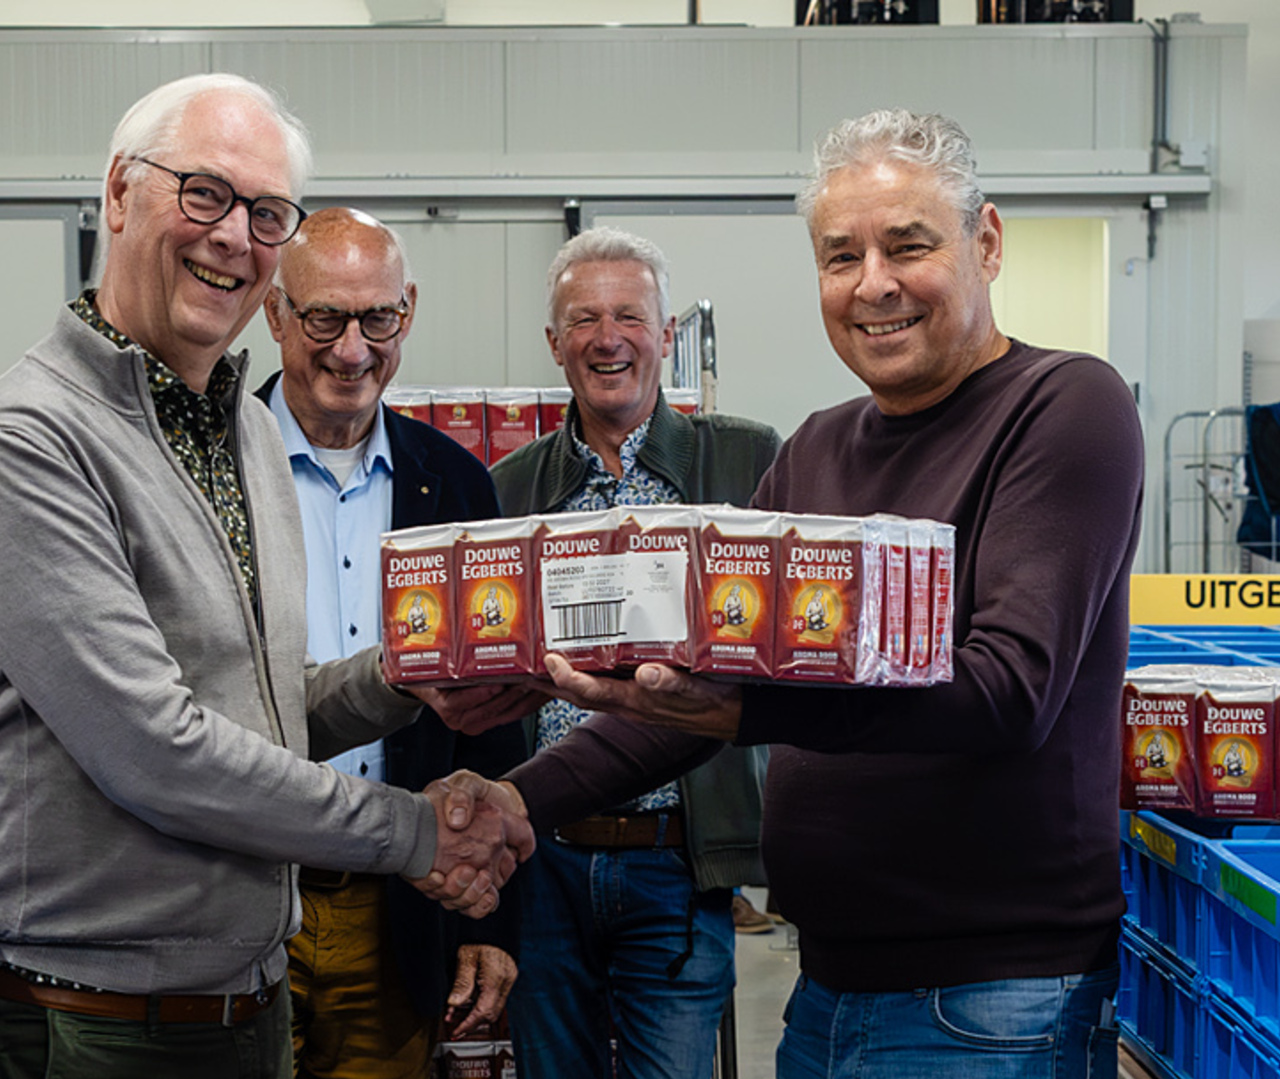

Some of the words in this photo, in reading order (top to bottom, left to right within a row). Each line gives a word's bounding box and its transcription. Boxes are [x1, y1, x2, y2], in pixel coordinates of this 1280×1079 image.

[462, 562, 524, 580] EGBERTS
[706, 560, 771, 575] EGBERTS
[786, 563, 854, 580] EGBERTS
[387, 570, 448, 588] EGBERTS
[1126, 712, 1188, 726] EGBERTS
[1204, 721, 1267, 734] EGBERTS
